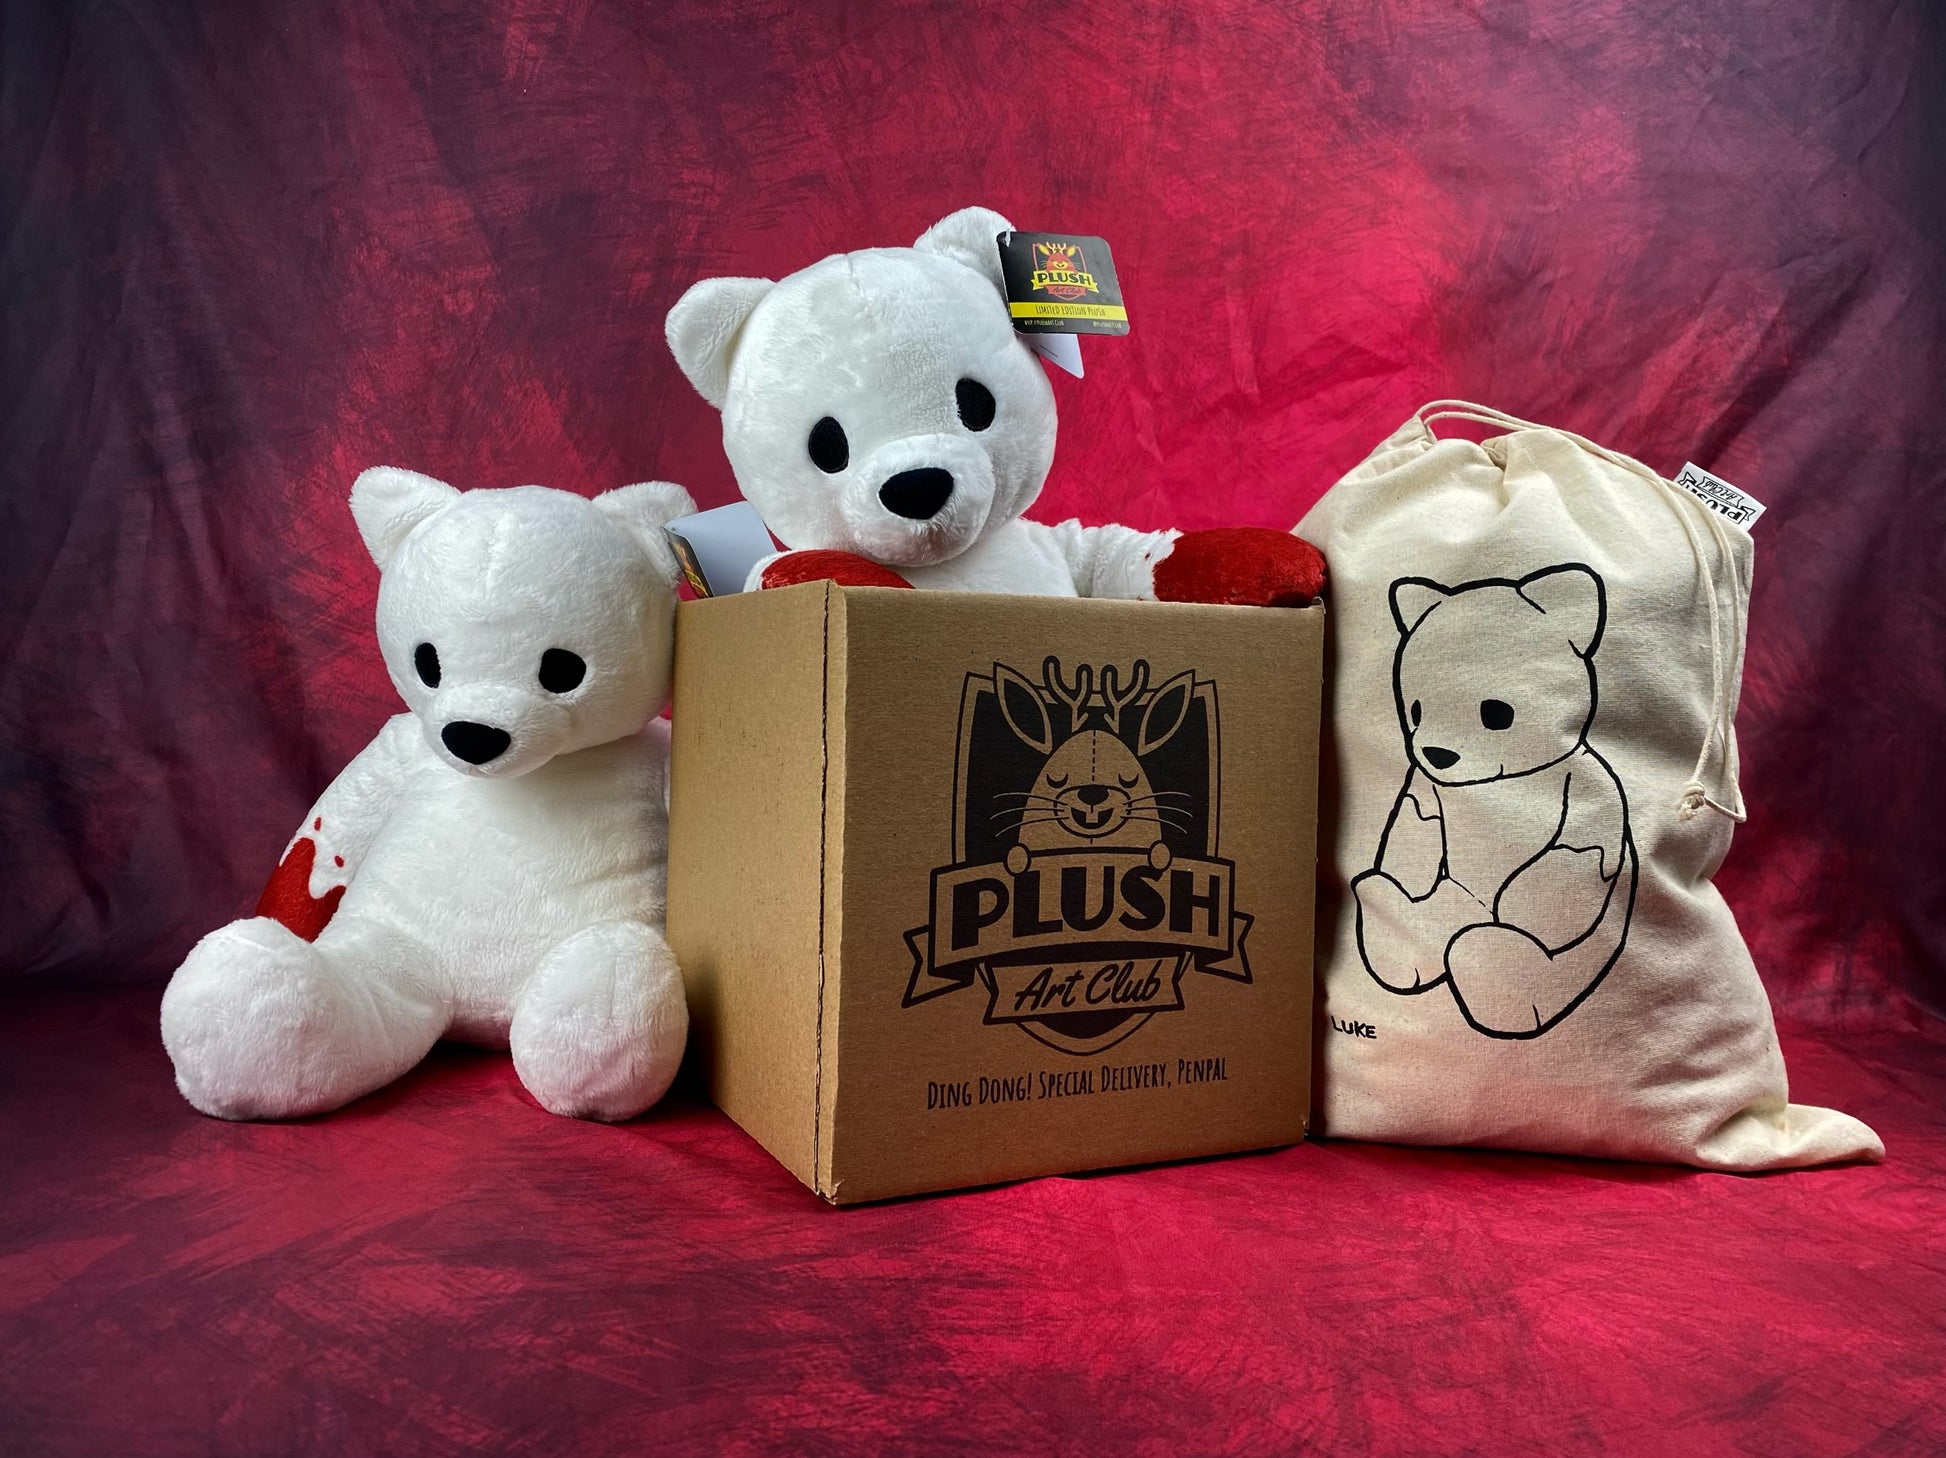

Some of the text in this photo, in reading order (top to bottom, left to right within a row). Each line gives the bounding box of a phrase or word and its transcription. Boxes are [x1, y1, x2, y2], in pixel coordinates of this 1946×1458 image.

[1037, 272, 1091, 286] PLUSH
[1036, 305, 1060, 315] LIMITED
[1061, 307, 1086, 316] EDITION
[951, 864, 1220, 951] PLUSH
[1013, 959, 1163, 1011] Art Club
[1330, 1015, 1377, 1039] LUKE
